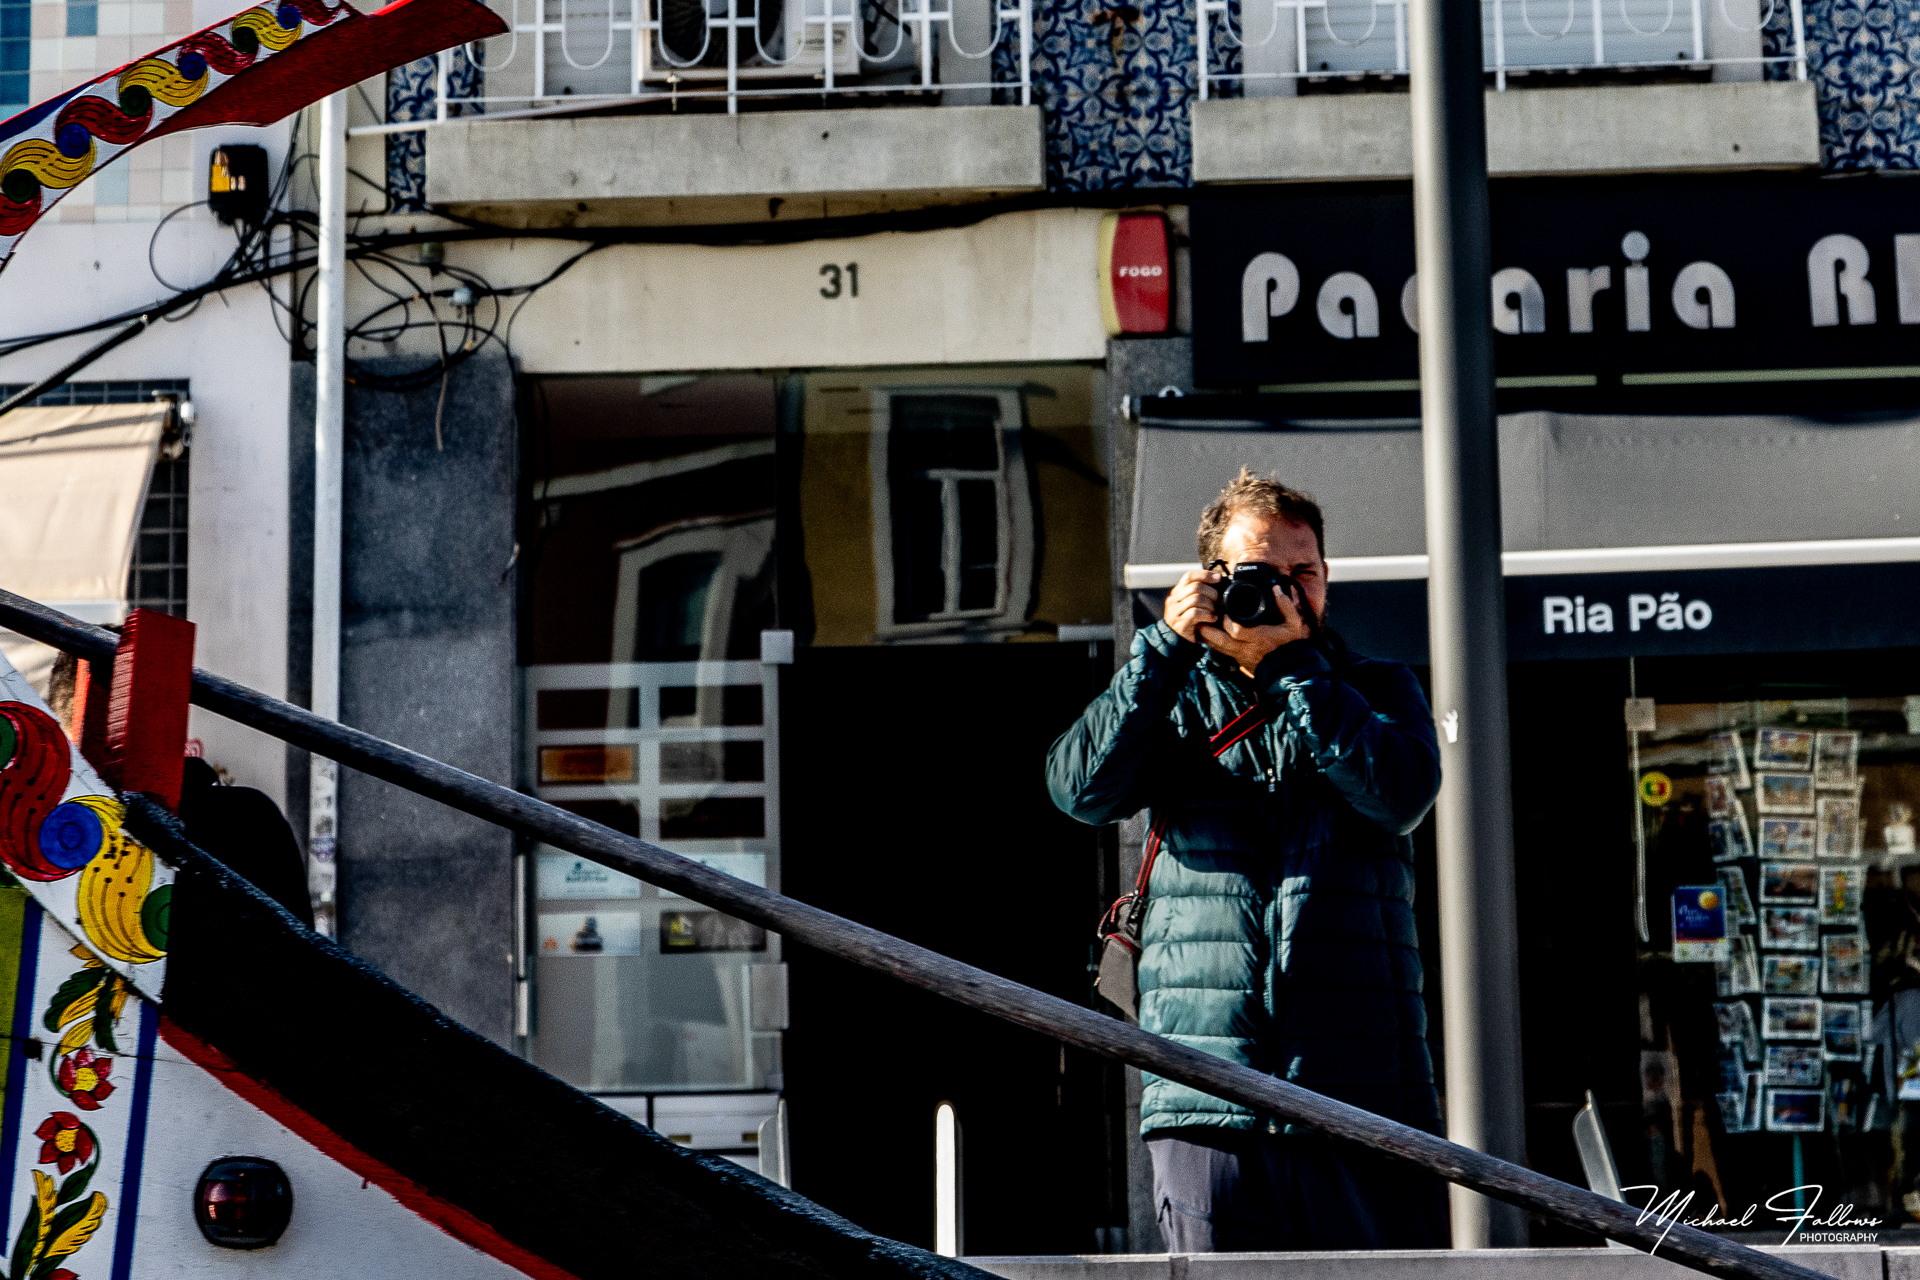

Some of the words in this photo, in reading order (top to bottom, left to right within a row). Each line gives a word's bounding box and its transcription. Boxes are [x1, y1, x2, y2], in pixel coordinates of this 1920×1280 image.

[819, 262, 859, 299] 31
[1119, 265, 1162, 277] FOGO
[1242, 231, 1736, 342] Paaria
[1543, 595, 1614, 634] Ria
[1628, 592, 1712, 632] Pão
